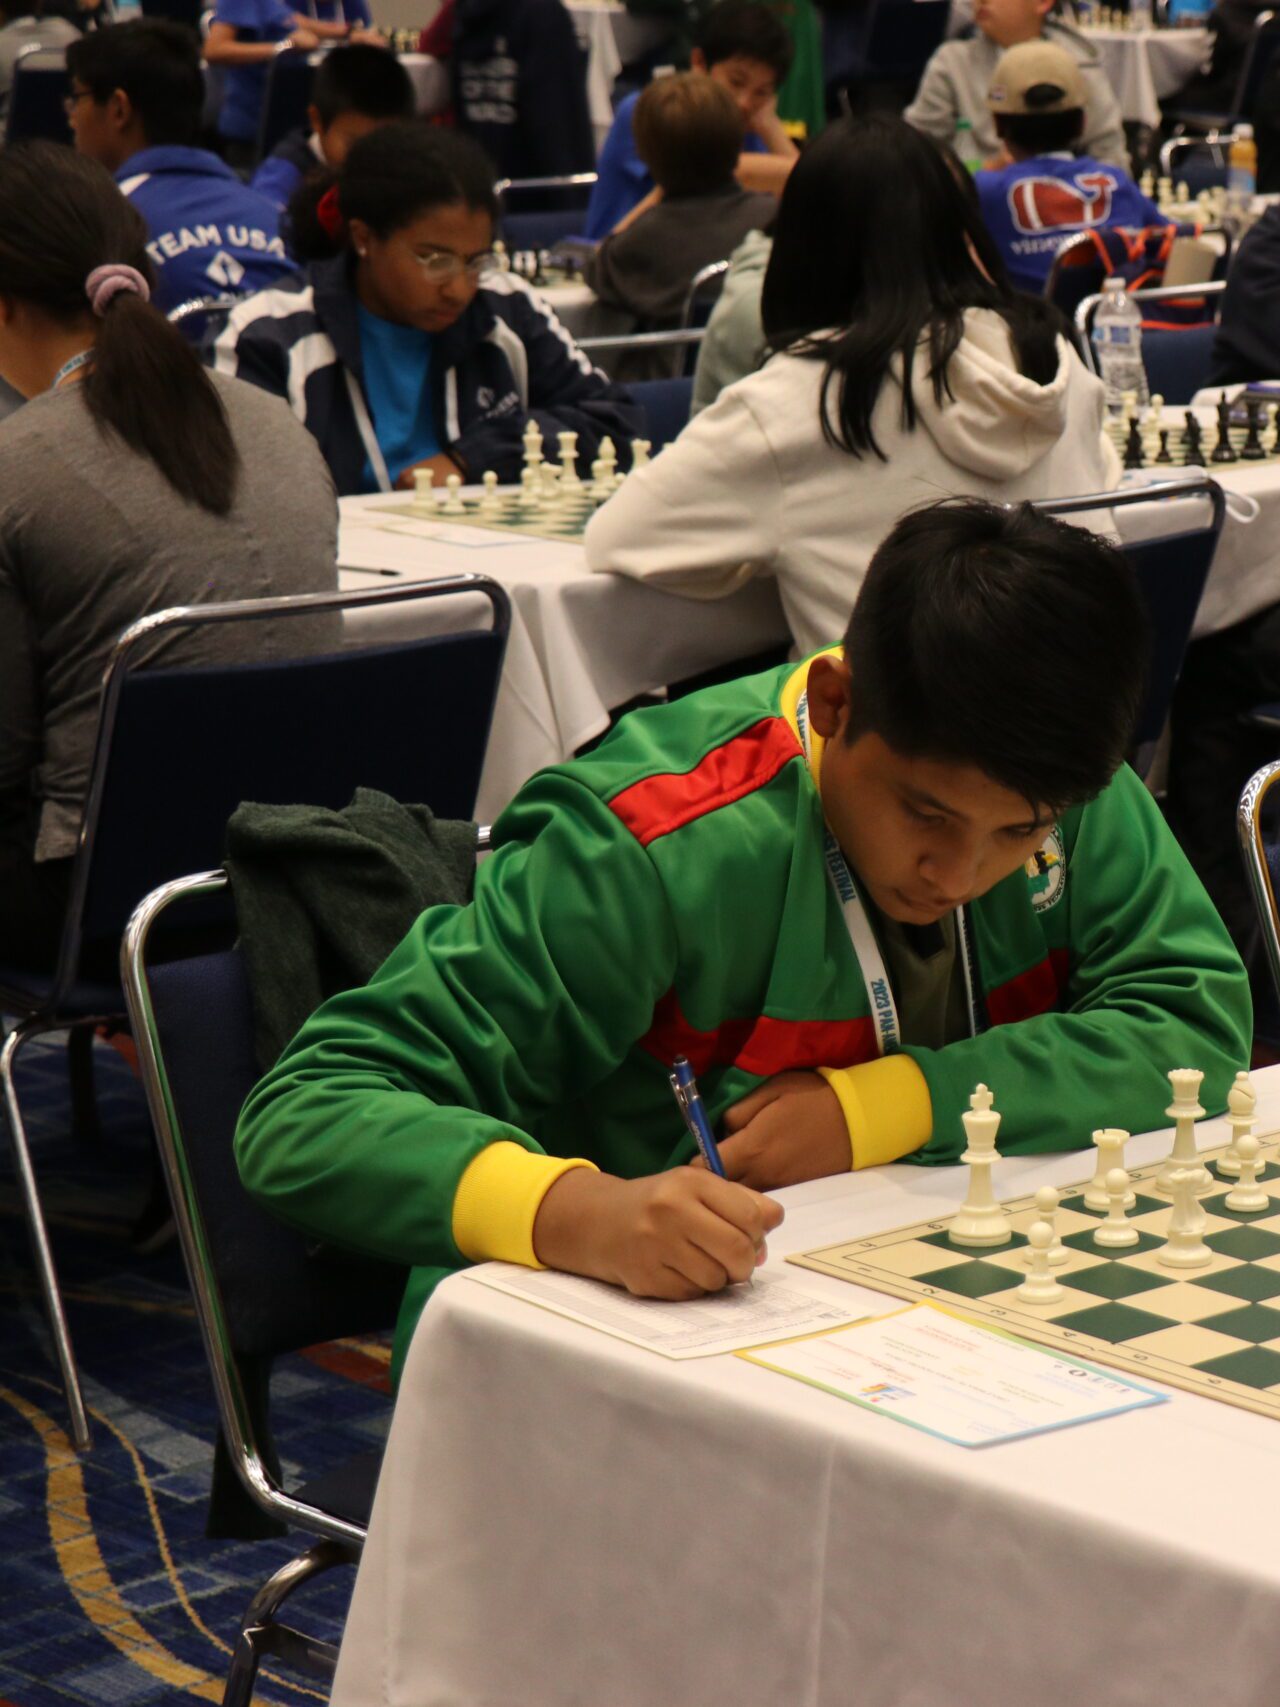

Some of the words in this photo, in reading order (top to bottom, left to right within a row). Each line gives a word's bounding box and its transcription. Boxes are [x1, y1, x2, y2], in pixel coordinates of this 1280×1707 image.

[145, 223, 223, 265] TEAM
[226, 223, 286, 260] USA
[826, 848, 857, 905] FESTIVAL
[870, 978, 885, 1010] 2023
